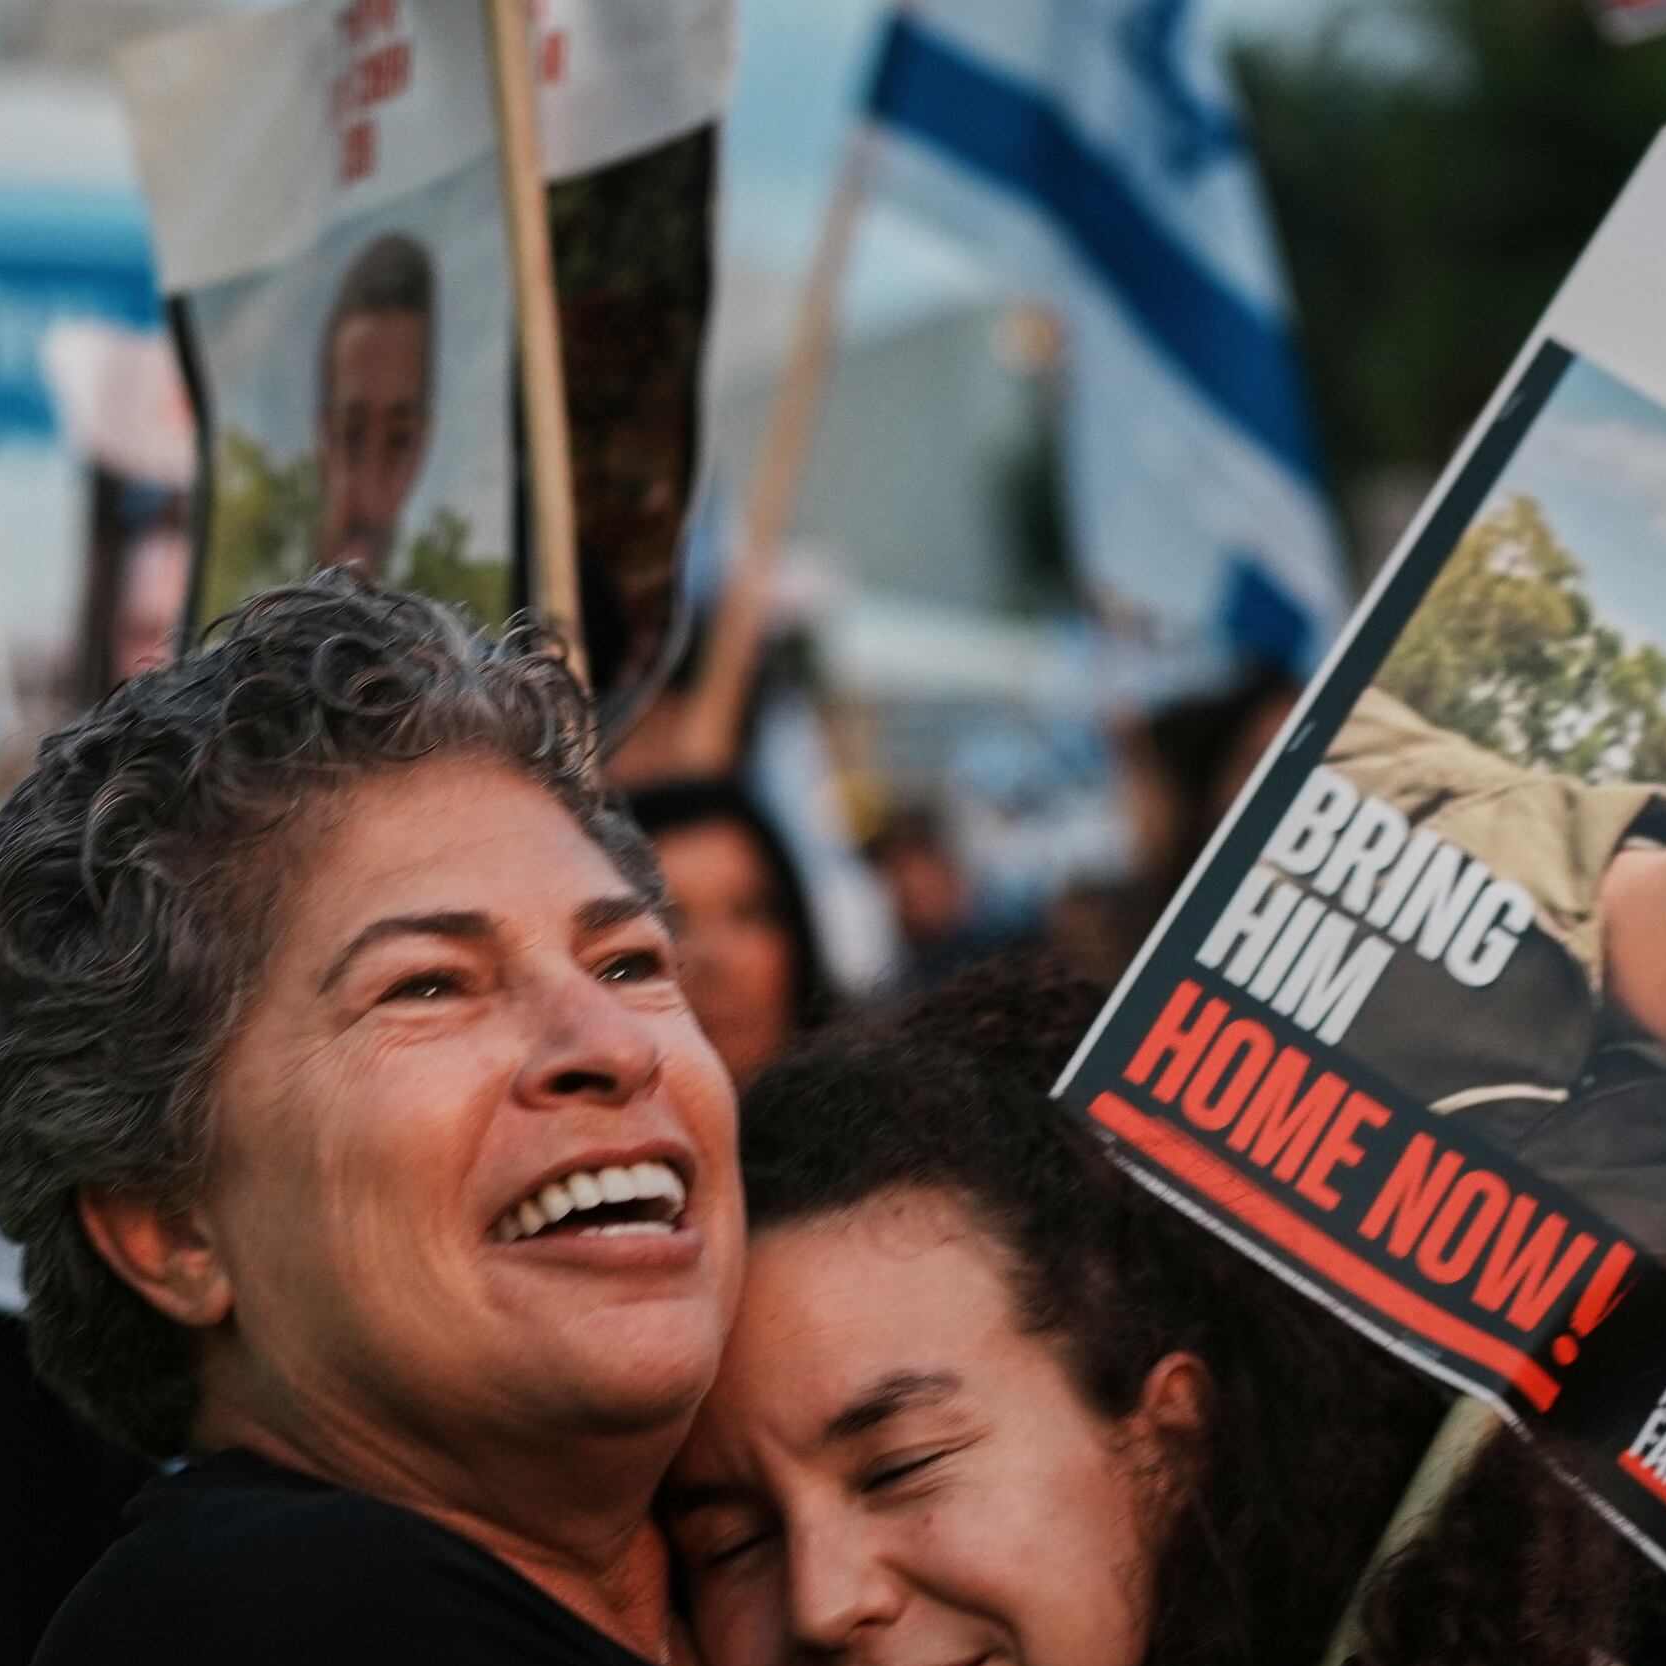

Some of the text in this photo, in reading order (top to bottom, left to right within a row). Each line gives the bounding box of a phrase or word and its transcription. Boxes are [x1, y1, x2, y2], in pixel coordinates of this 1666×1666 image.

[1195, 866, 1394, 1046] HIM
[1261, 766, 1535, 987] BRING
[1123, 979, 1636, 1367] HOME NOW!
